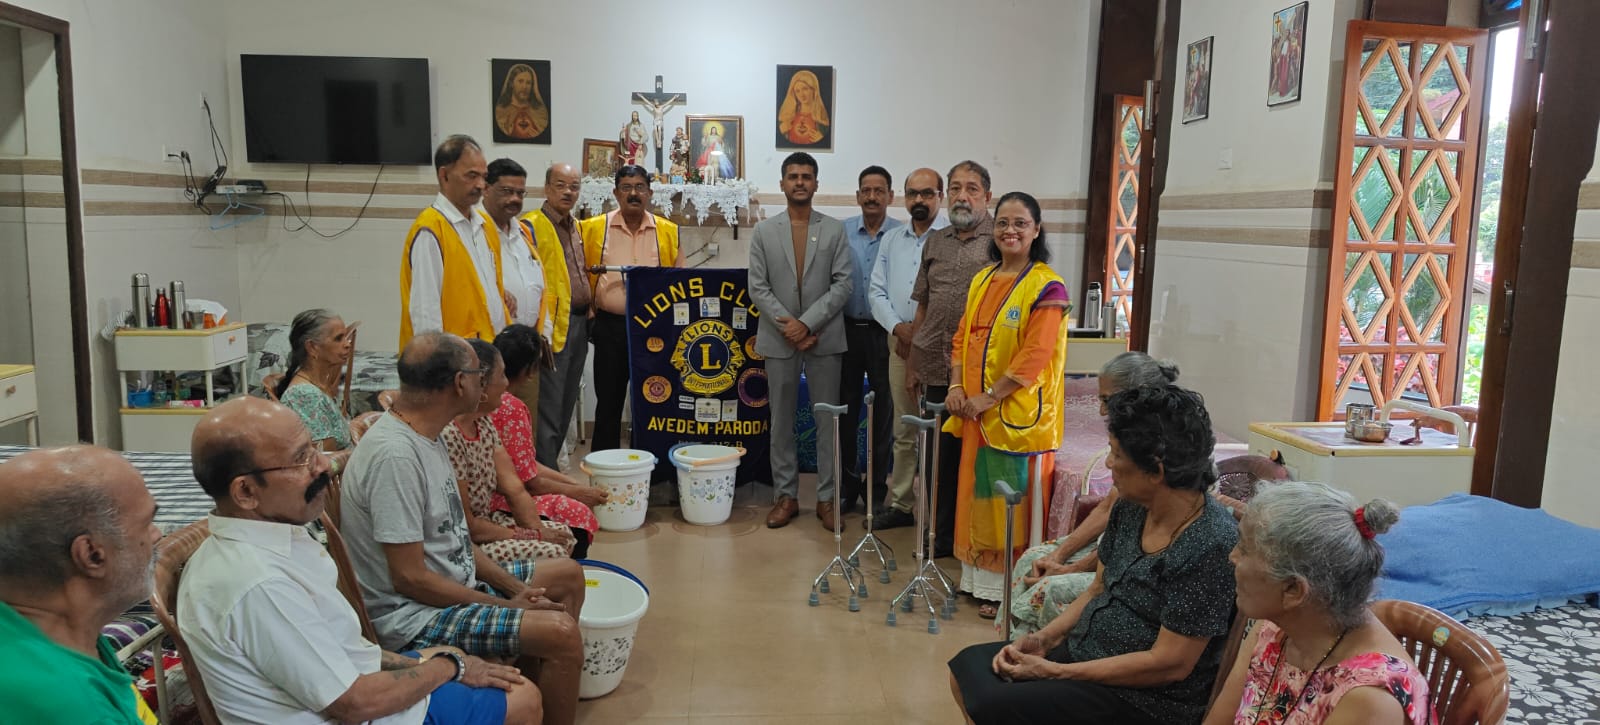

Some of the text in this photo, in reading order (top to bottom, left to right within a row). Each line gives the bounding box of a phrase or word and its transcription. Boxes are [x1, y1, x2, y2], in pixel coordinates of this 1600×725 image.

[634, 278, 704, 328] LIONS
[686, 323, 730, 339] LIONS
[700, 344, 721, 369] L
